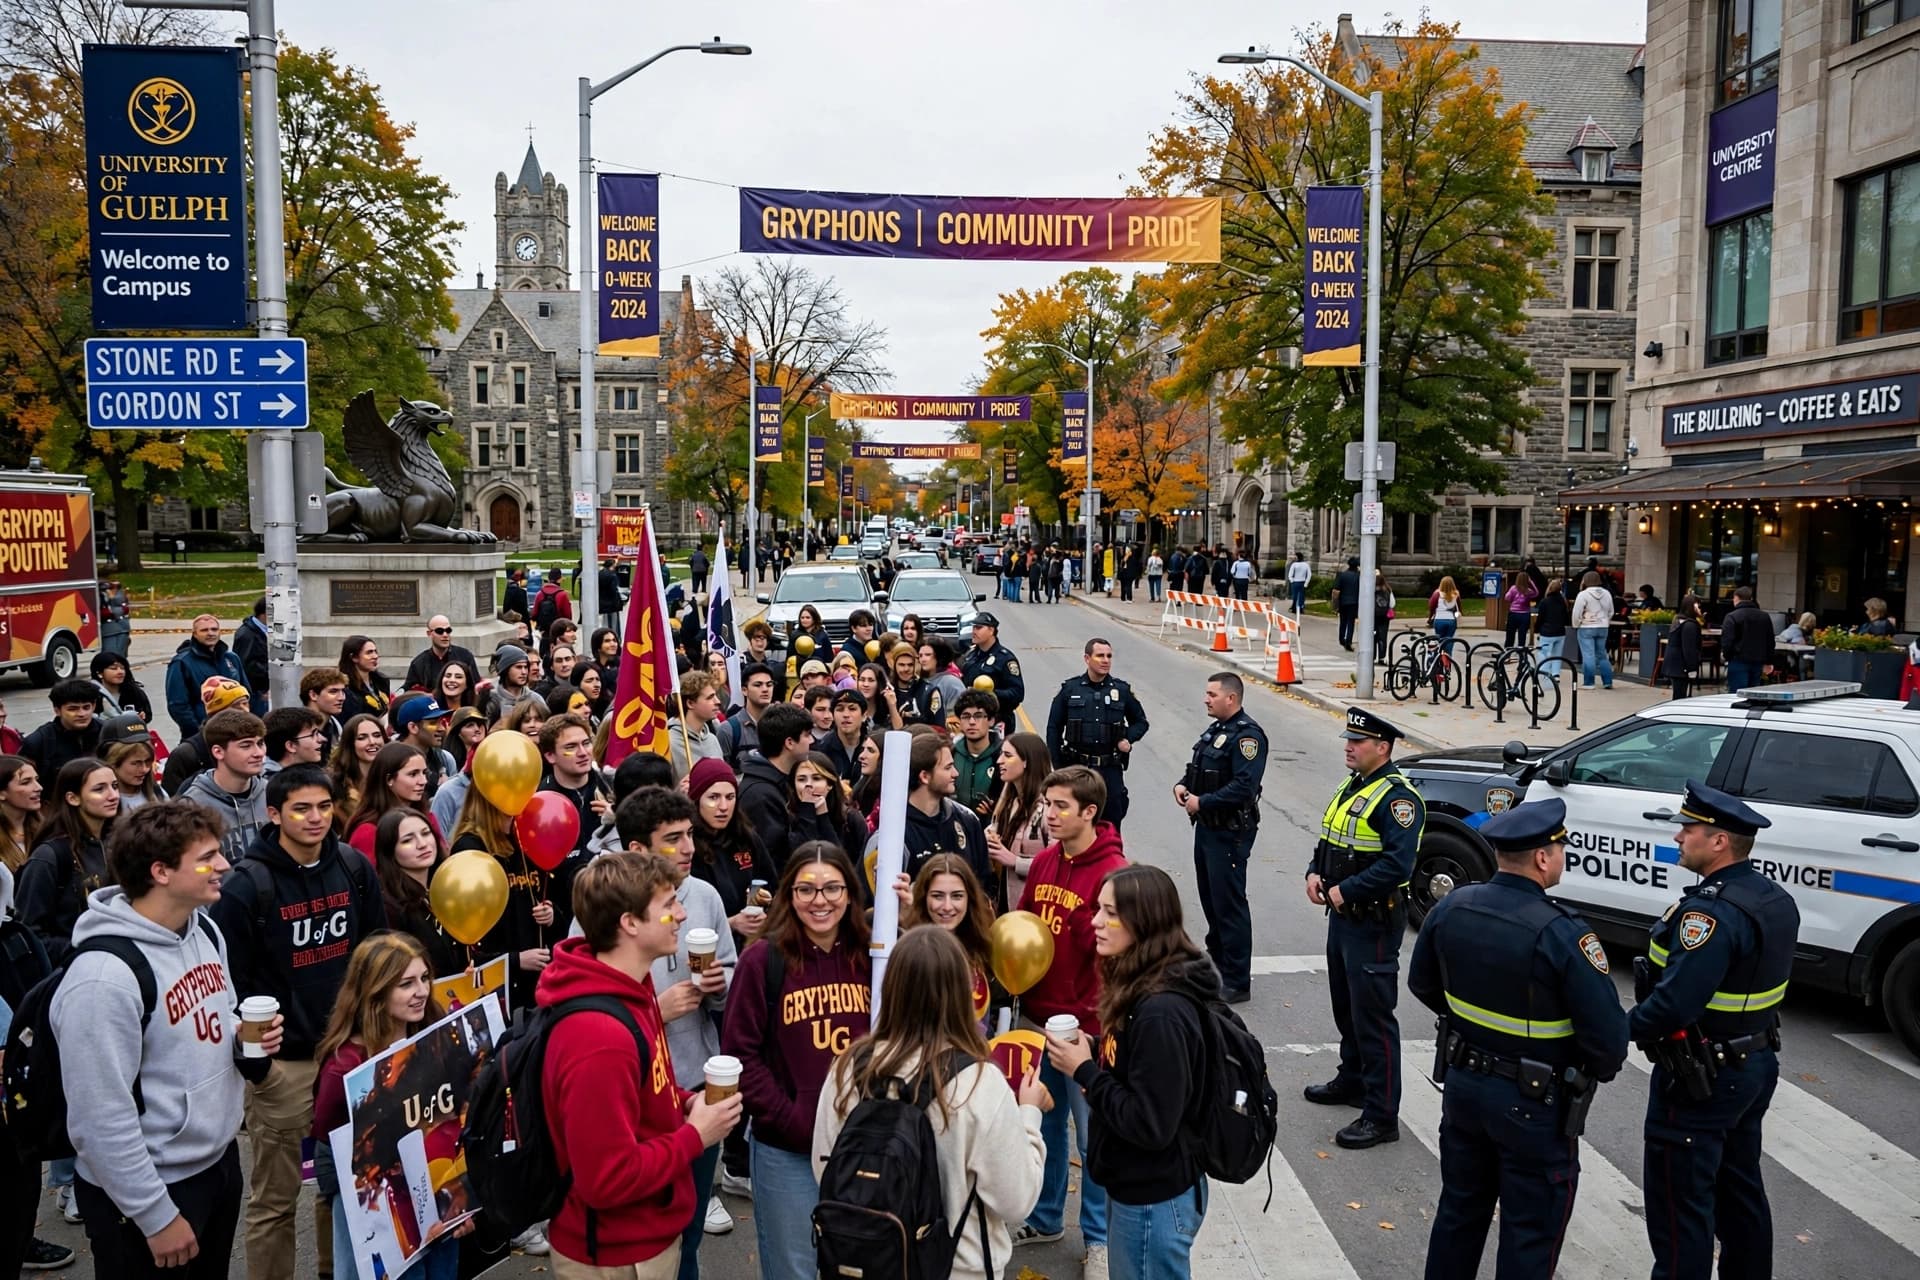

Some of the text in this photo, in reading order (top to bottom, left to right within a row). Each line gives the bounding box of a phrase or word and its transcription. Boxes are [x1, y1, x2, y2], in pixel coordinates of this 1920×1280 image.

[1713, 128, 1775, 166] UNIVERSITY
[99, 155, 228, 175] UNIVERSITY
[1720, 153, 1762, 182] CENTRE
[100, 175, 127, 192] OF
[100, 195, 229, 222] GUELPH
[600, 214, 656, 232] WELCOME
[762, 205, 901, 243] GRYPHONS
[937, 211, 1093, 246] COMMUNITY
[1128, 215, 1200, 247] PRIDE
[1308, 227, 1360, 244] WELCOME
[101, 249, 229, 271] Welcome to
[606, 238, 651, 262] BACK
[1313, 250, 1354, 273] BACK
[103, 276, 191, 300] Campus
[605, 271, 652, 288] O-WEEK
[1311, 282, 1354, 299] O-WEEK
[611, 299, 647, 319] 2024
[1315, 309, 1349, 329] 2024
[95, 347, 244, 376] STONE RD E
[98, 392, 241, 420] GORDON ST
[841, 400, 898, 417] GRYPHONS
[912, 402, 976, 416] COMMUNITY
[990, 402, 1020, 417] PRIDE
[1672, 411, 1695, 435] THE
[1698, 403, 1762, 433] BULLRING
[1779, 395, 1835, 424] COFFEE
[1840, 391, 1852, 417] &
[1857, 384, 1901, 415] EATS
[0, 508, 65, 539] GRYPPH
[0, 541, 69, 574] POUTINE
[1569, 831, 1650, 860] GUELPH
[1565, 851, 1833, 889] POLICE ERVICE
[1040, 904, 1062, 935] UG
[783, 983, 871, 1025] GRYPHONS
[193, 1006, 223, 1044] UG
[811, 1018, 850, 1056] UG
